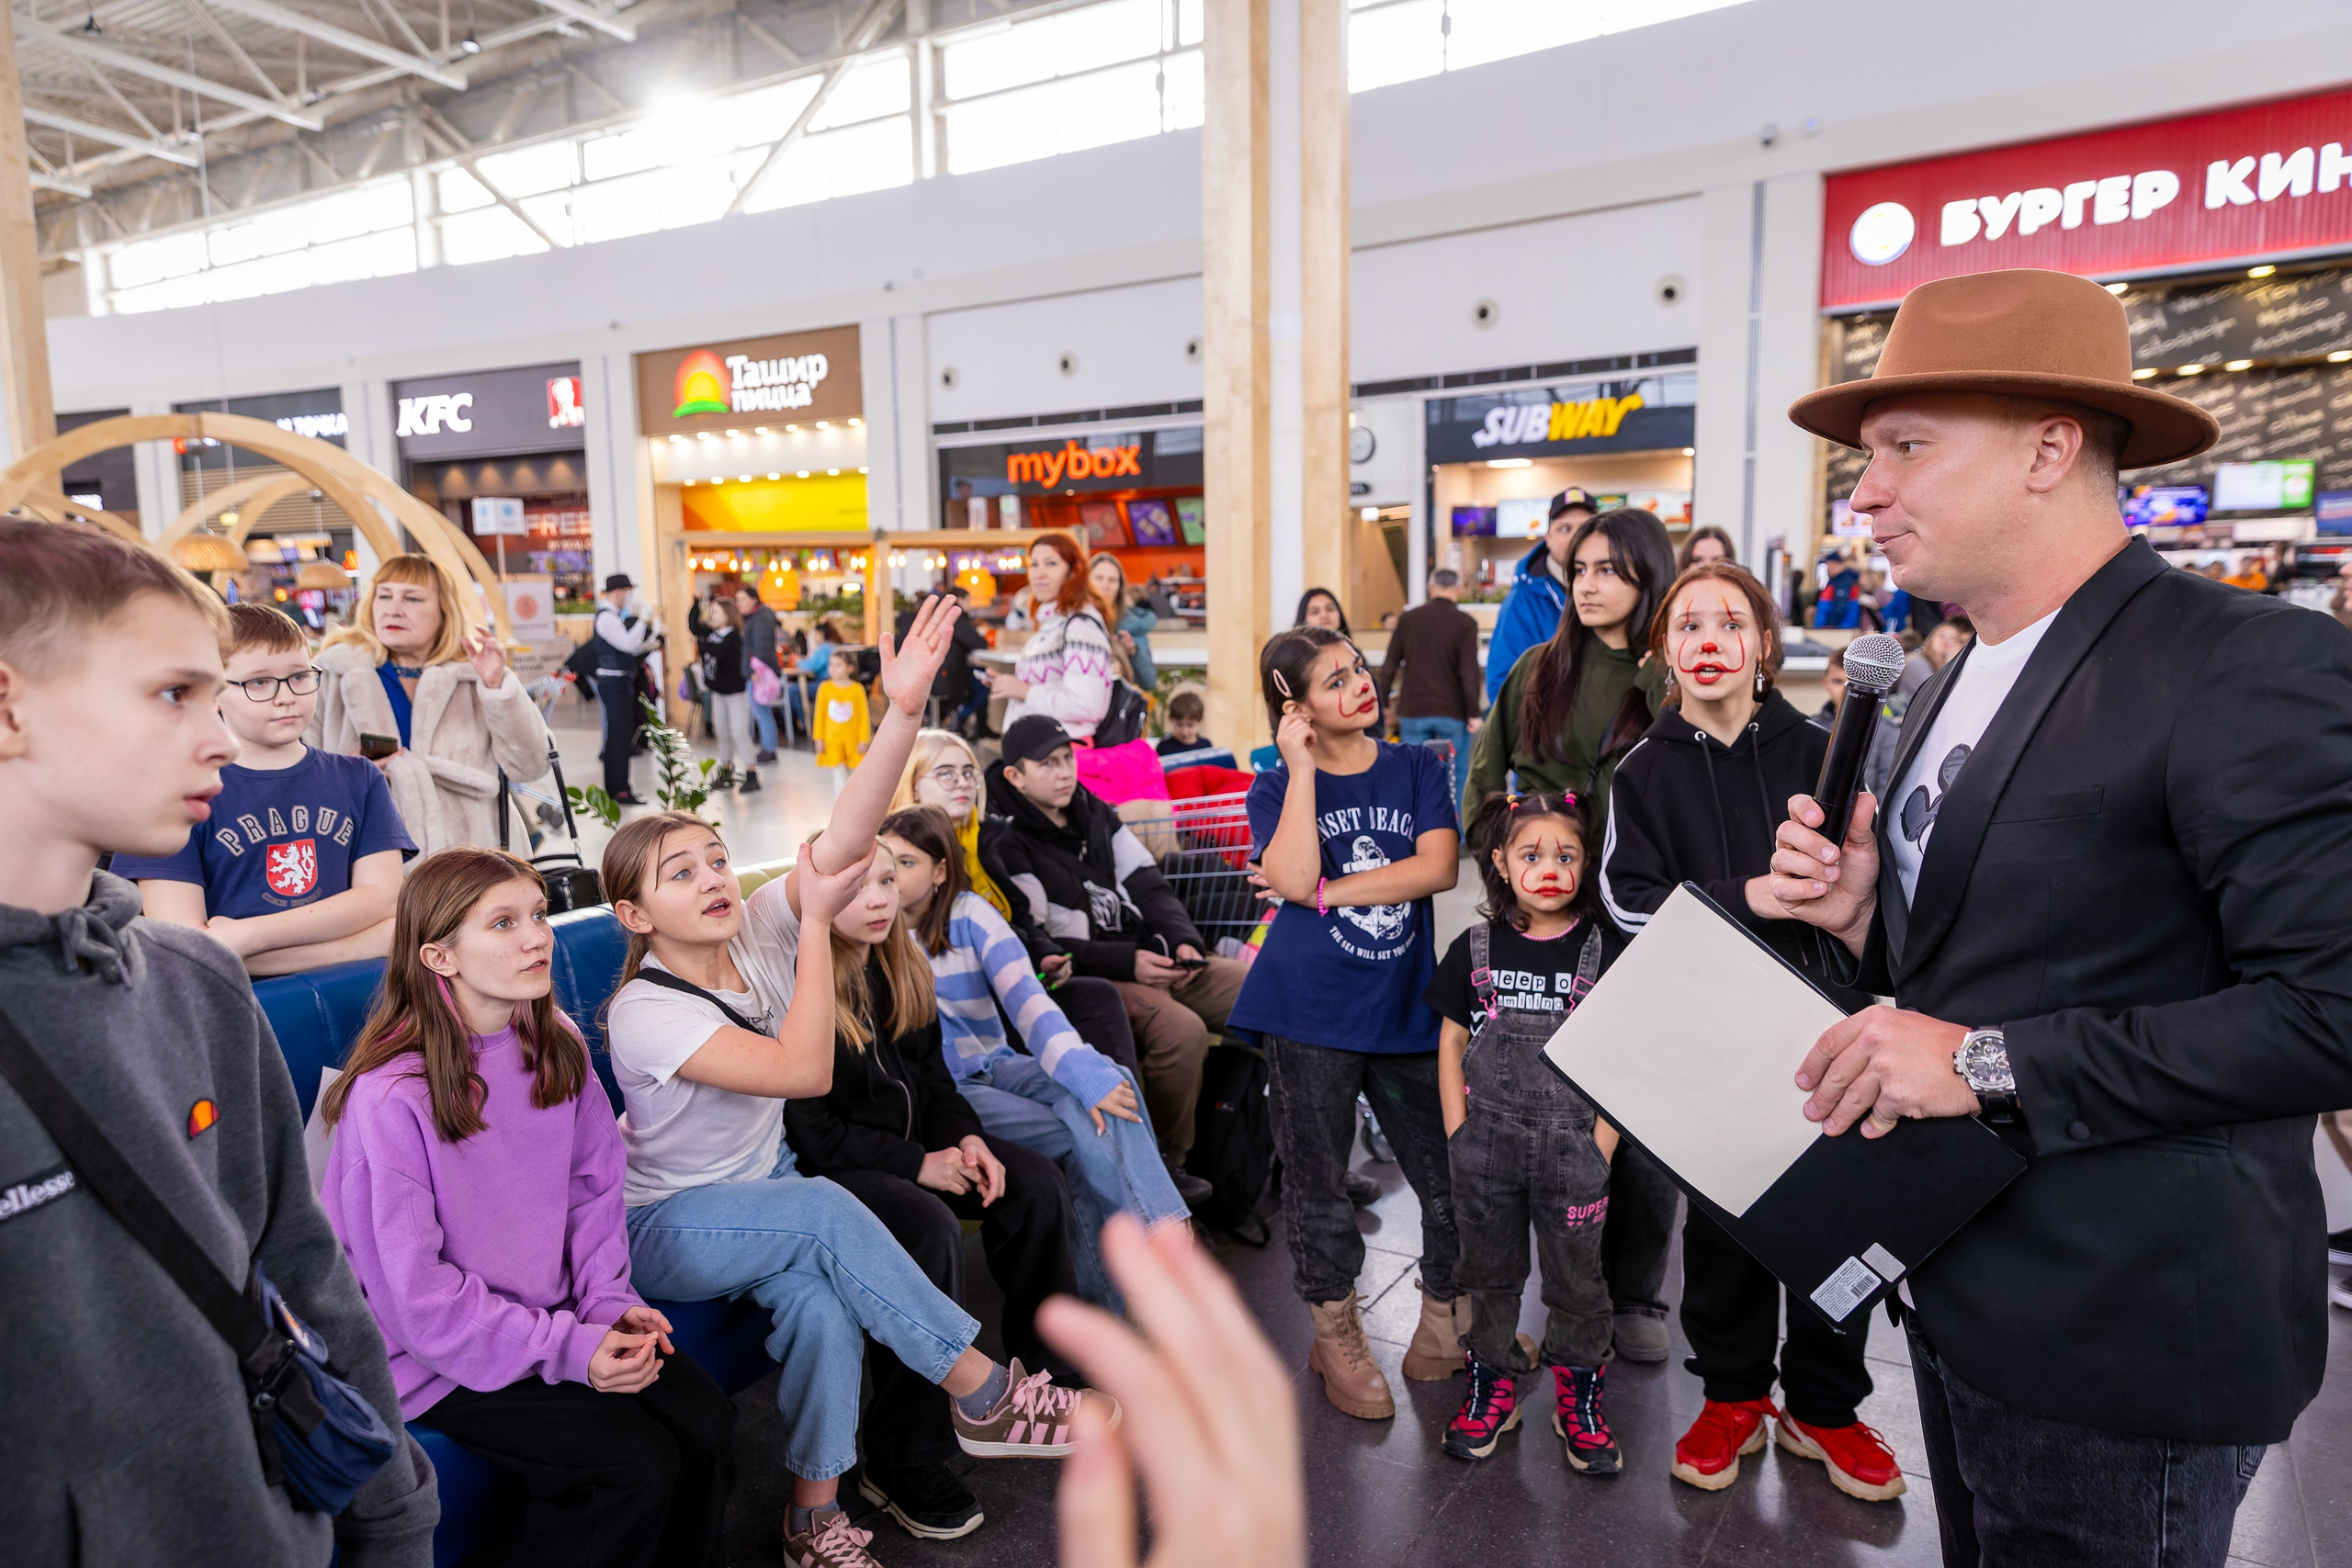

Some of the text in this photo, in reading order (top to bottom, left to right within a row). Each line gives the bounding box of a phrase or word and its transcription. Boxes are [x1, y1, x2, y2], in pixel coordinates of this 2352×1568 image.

[1940, 170, 2180, 247] БУРГЕР
[726, 354, 828, 389] Ташир
[396, 392, 473, 437] KFC
[730, 382, 812, 412] пицца
[1471, 392, 1644, 449] SUBWAY
[1007, 440, 1141, 489] mybox
[216, 805, 354, 857] PRAGUE
[1329, 925, 1343, 943] THE
[1340, 939, 1355, 954] SEA
[1356, 946, 1375, 961] WILL
[1377, 949, 1391, 961] SET
